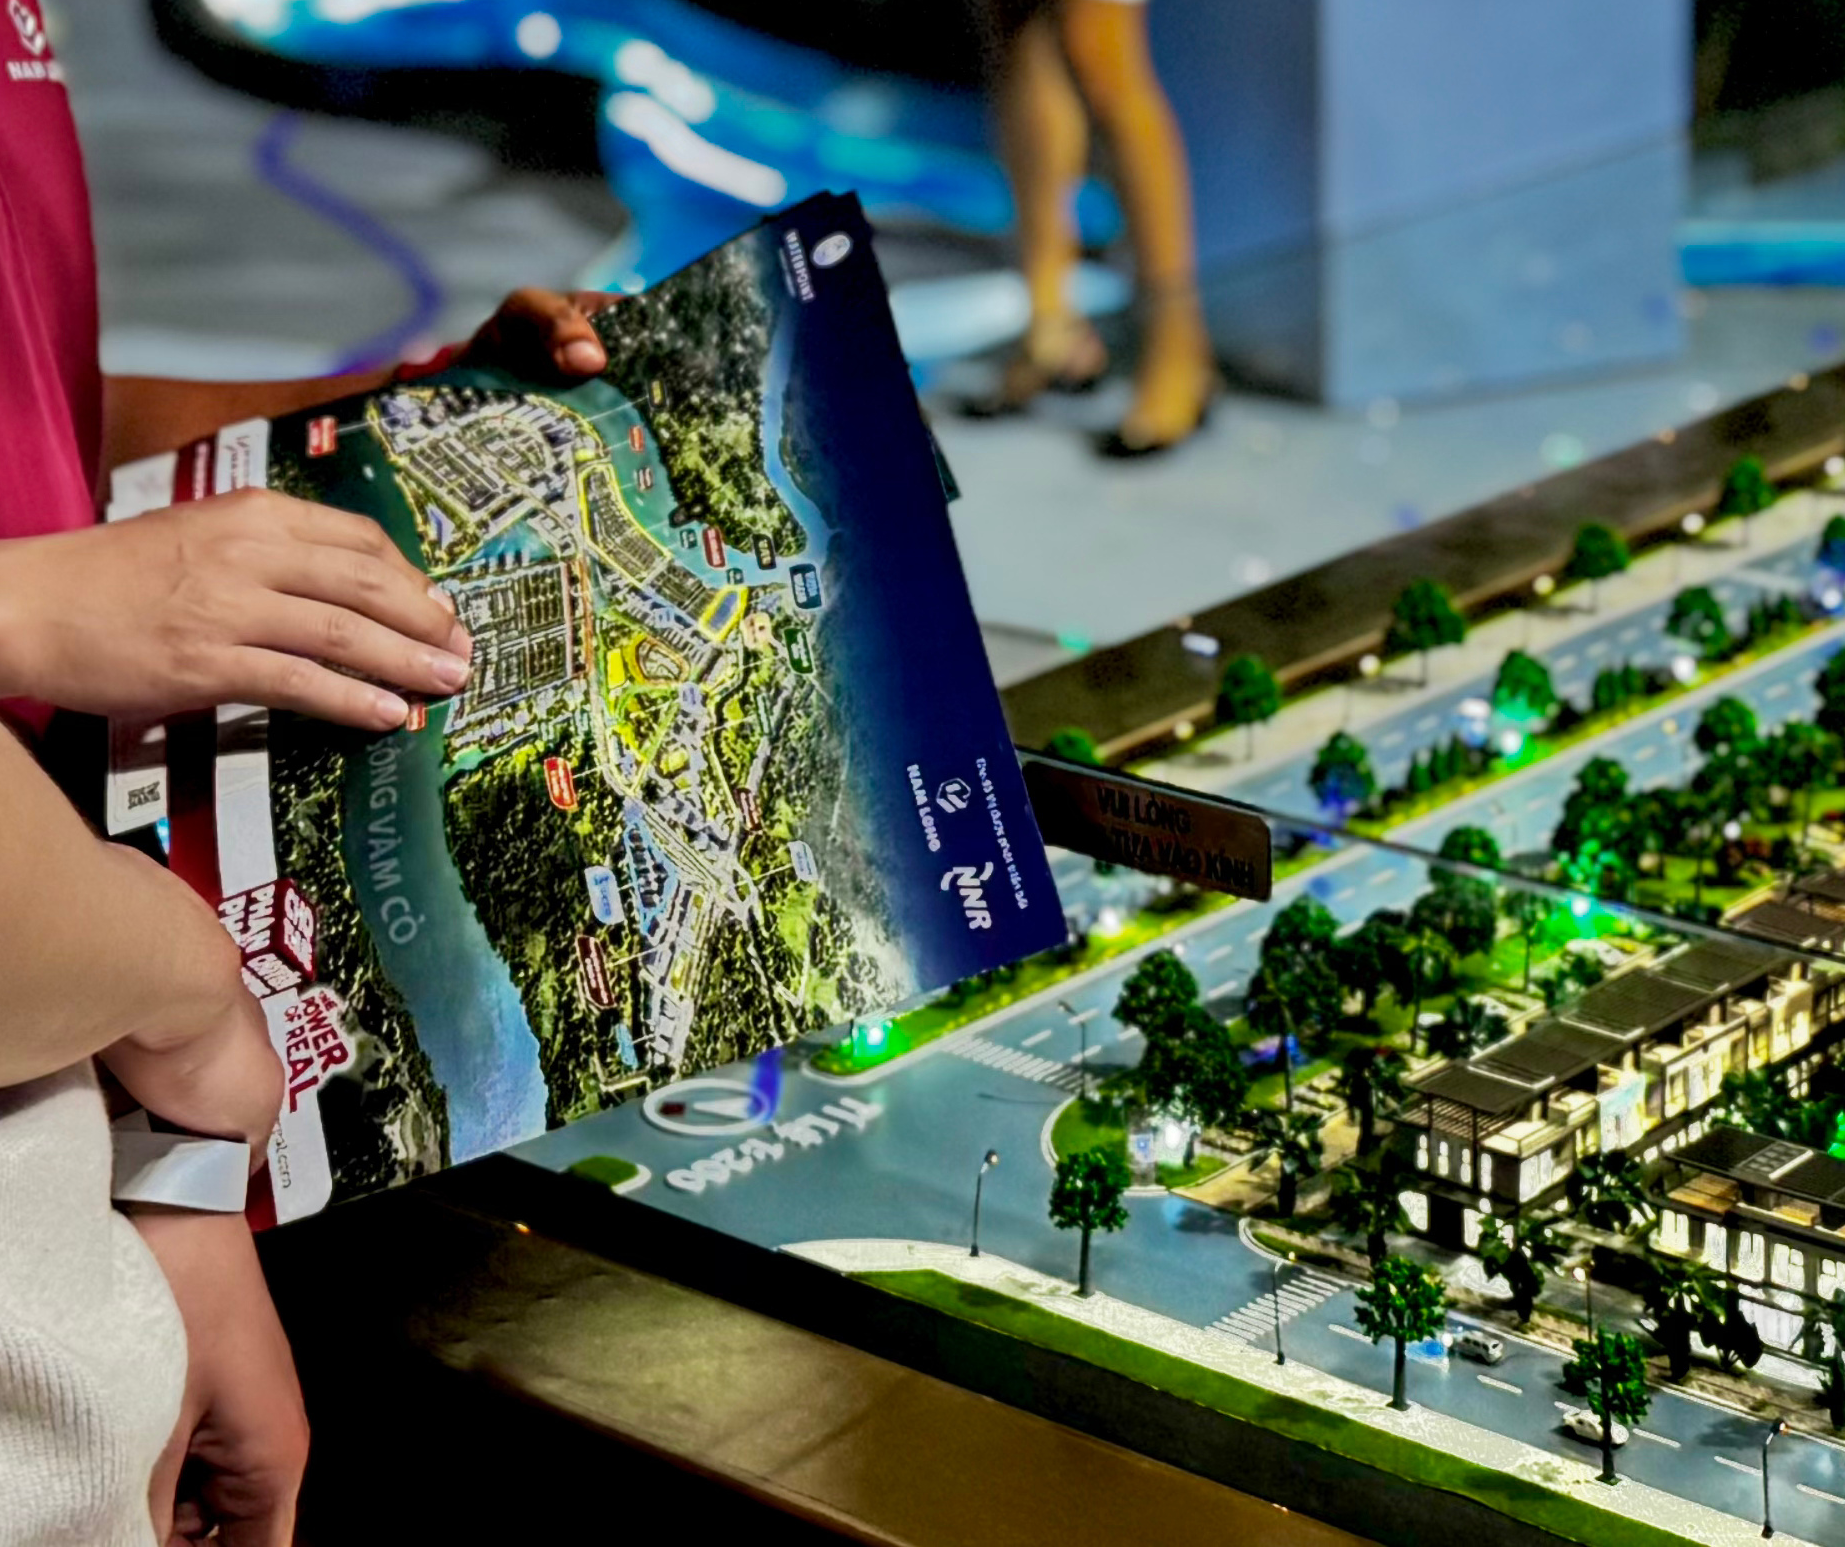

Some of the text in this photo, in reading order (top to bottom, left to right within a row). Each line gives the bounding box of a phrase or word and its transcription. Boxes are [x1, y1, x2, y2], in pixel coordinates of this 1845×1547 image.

[367, 812, 403, 893] VÀM
[286, 1024, 319, 1114] REAL
[301, 995, 349, 1074] POWER
